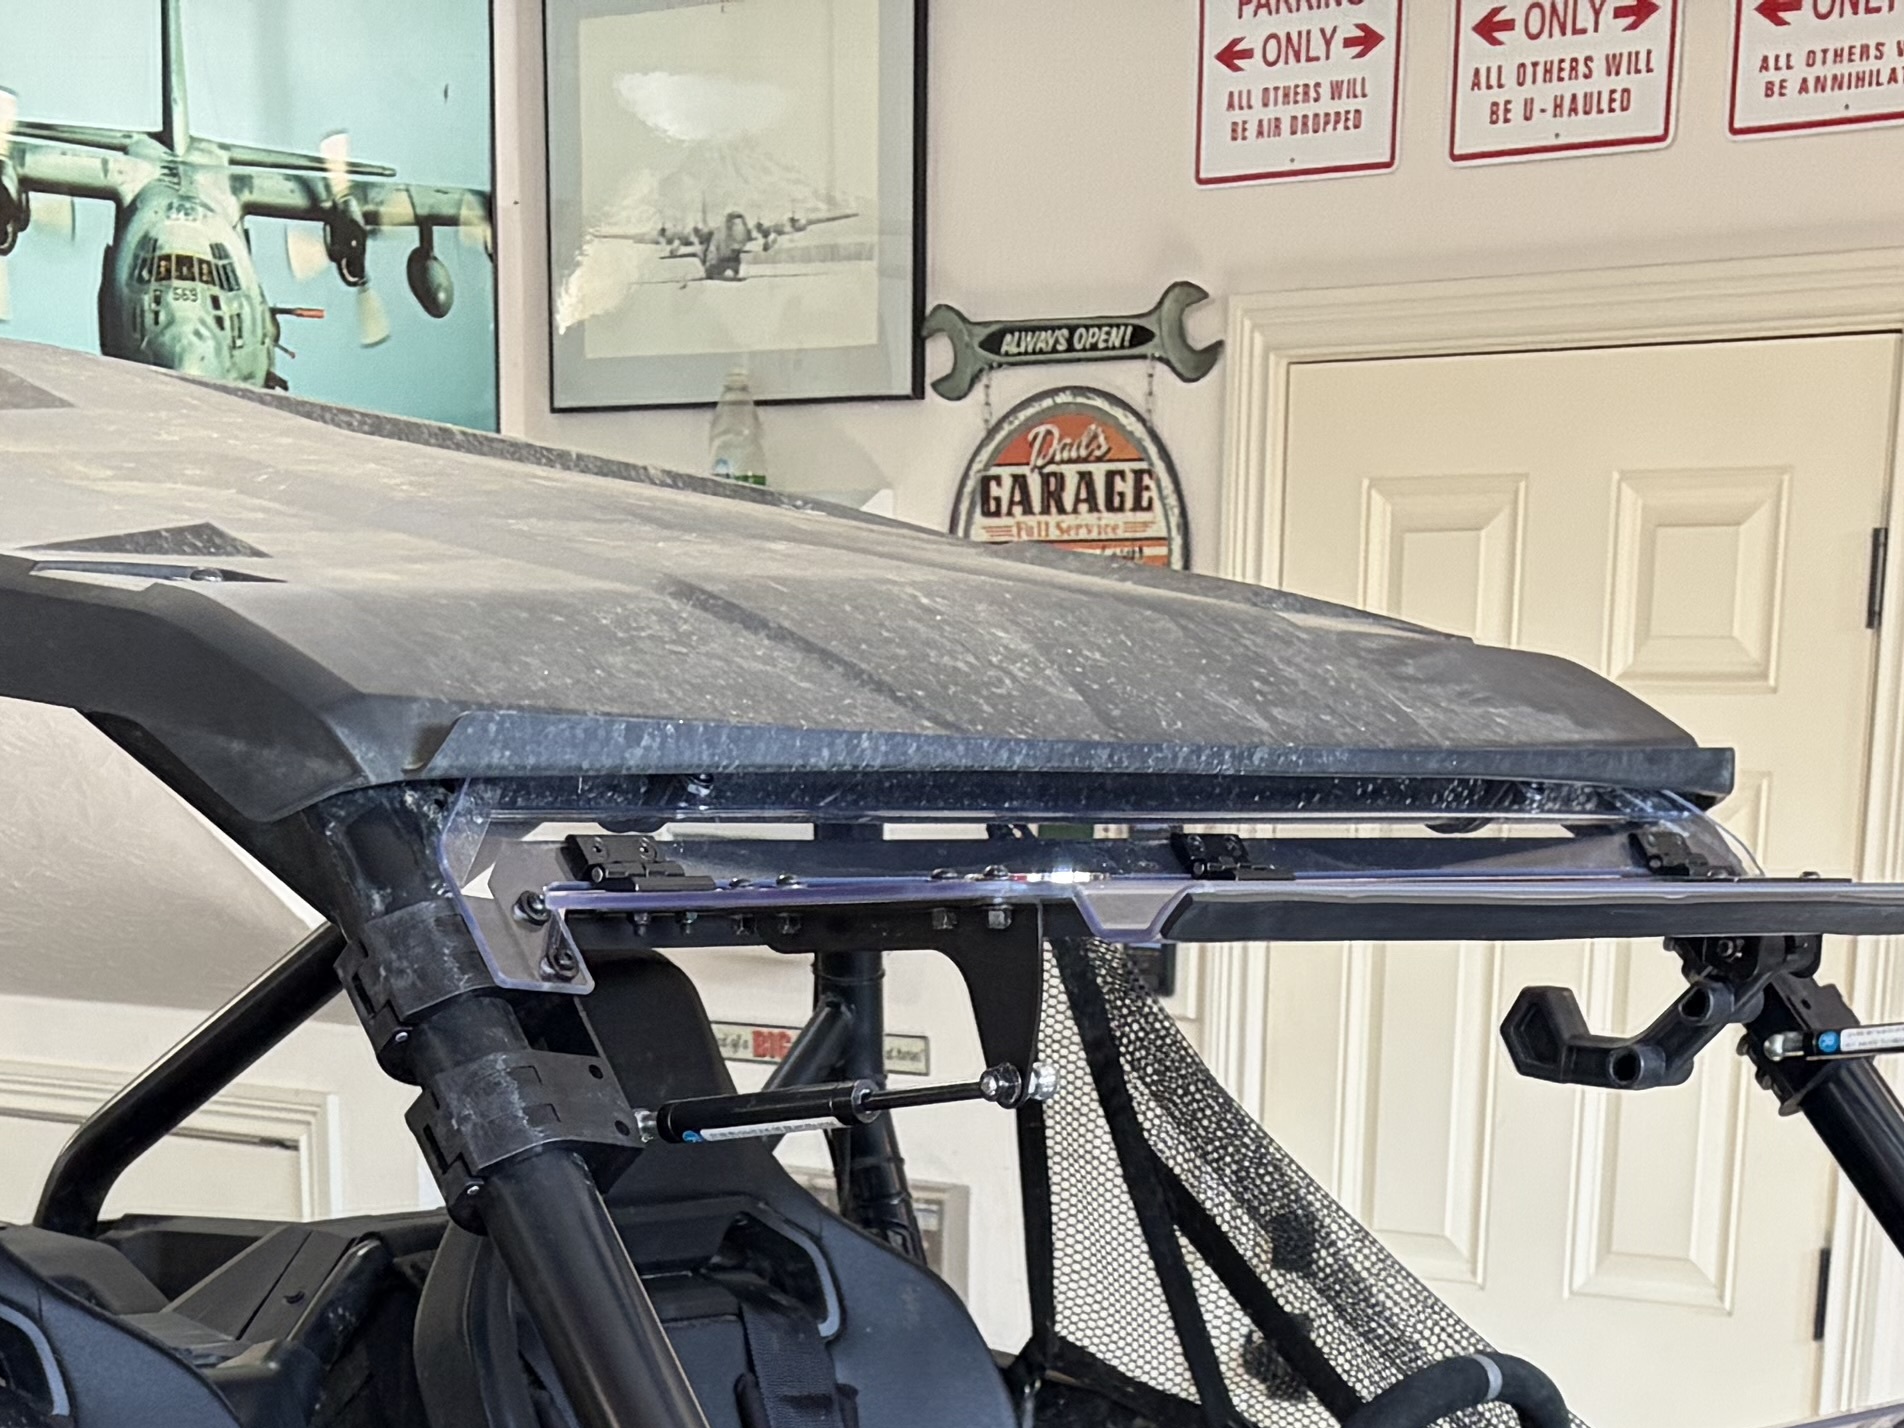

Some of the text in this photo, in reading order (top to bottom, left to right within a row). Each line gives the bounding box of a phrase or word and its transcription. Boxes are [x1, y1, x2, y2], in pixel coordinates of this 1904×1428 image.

[1524, 0, 1607, 40] ONLY
[1262, 25, 1338, 67] ONLY
[1759, 53, 1794, 73] ALL
[1805, 42, 1886, 68] OTHERS
[1471, 49, 1654, 91] ALL OTHERS WILL
[1226, 76, 1368, 112] ALL OTHERS WILL
[1764, 78, 1788, 98] BE
[1230, 109, 1362, 141] BE AIR DROPPED
[1489, 99, 1513, 125] BE
[1001, 325, 1133, 355] ALWAYS OPEN!
[1027, 423, 1113, 473] Dad's
[980, 468, 1155, 518] GARAGE
[1014, 518, 1121, 539] Full Service
